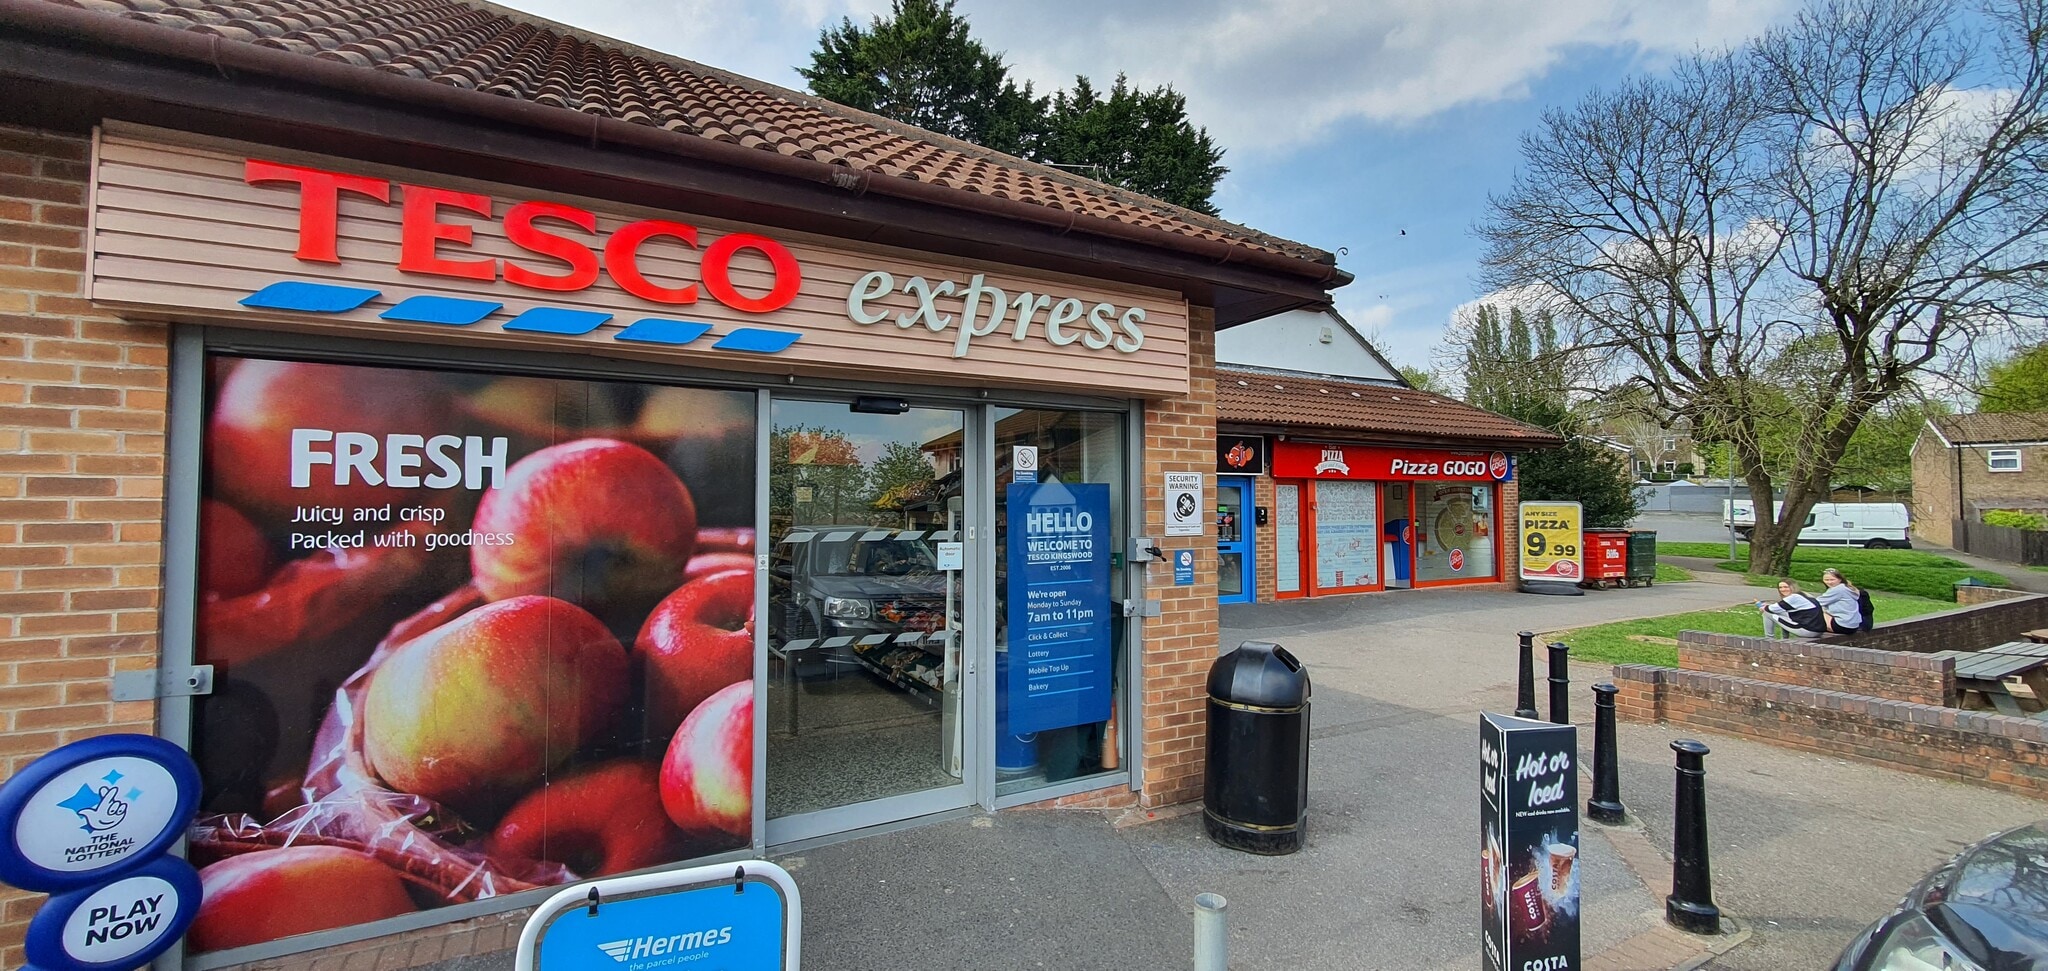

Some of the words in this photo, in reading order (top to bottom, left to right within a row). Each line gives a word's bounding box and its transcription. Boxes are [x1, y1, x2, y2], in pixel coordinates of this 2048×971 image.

[244, 159, 801, 313] TESCO
[846, 270, 1146, 359] express
[291, 429, 508, 490] FRESH
[1322, 450, 1343, 462] PIZZA
[1391, 459, 1438, 475] Pizza
[1443, 460, 1486, 476] GOGO
[291, 505, 343, 525] Juicy
[353, 503, 391, 522] and
[399, 505, 445, 526] crisp
[1026, 511, 1093, 533] HELLO
[291, 530, 364, 549] Packed
[373, 529, 416, 547] with
[425, 529, 514, 551] goodness
[1027, 540, 1078, 552] WELCOME
[1080, 540, 1093, 549] TO
[1027, 553, 1050, 561] TESCO
[1050, 552, 1093, 560] KINGSWOOD
[1027, 590, 1048, 599] We're
[1049, 590, 1066, 599] open
[1027, 601, 1051, 609] Monday
[1060, 599, 1082, 607] Sunday
[1027, 612, 1050, 623] 7am
[1053, 611, 1063, 620] to
[1066, 608, 1094, 620] 11pm
[1028, 633, 1042, 641] Click
[1048, 631, 1068, 639] Collect
[1028, 650, 1049, 658] Lottery
[1028, 666, 1048, 675] Mobile
[1049, 665, 1060, 673] Top
[1061, 664, 1069, 672] Up
[1028, 683, 1049, 691] Bakery
[1516, 751, 1547, 782] Hot
[1549, 751, 1570, 772] or
[1528, 773, 1564, 808] Iced
[64, 836, 136, 856] NATIONAL
[90, 832, 118, 844] THE
[66, 845, 131, 863] LOTTERY
[1551, 863, 1559, 890] COSTA
[88, 893, 164, 927] PLAY
[1524, 891, 1537, 920] COSTA
[85, 913, 161, 946] NOW
[631, 926, 732, 959] Hermes
[630, 963, 644, 971] the
[646, 956, 676, 970] parcel
[677, 951, 709, 965] people
[1523, 955, 1568, 971] COSTA
